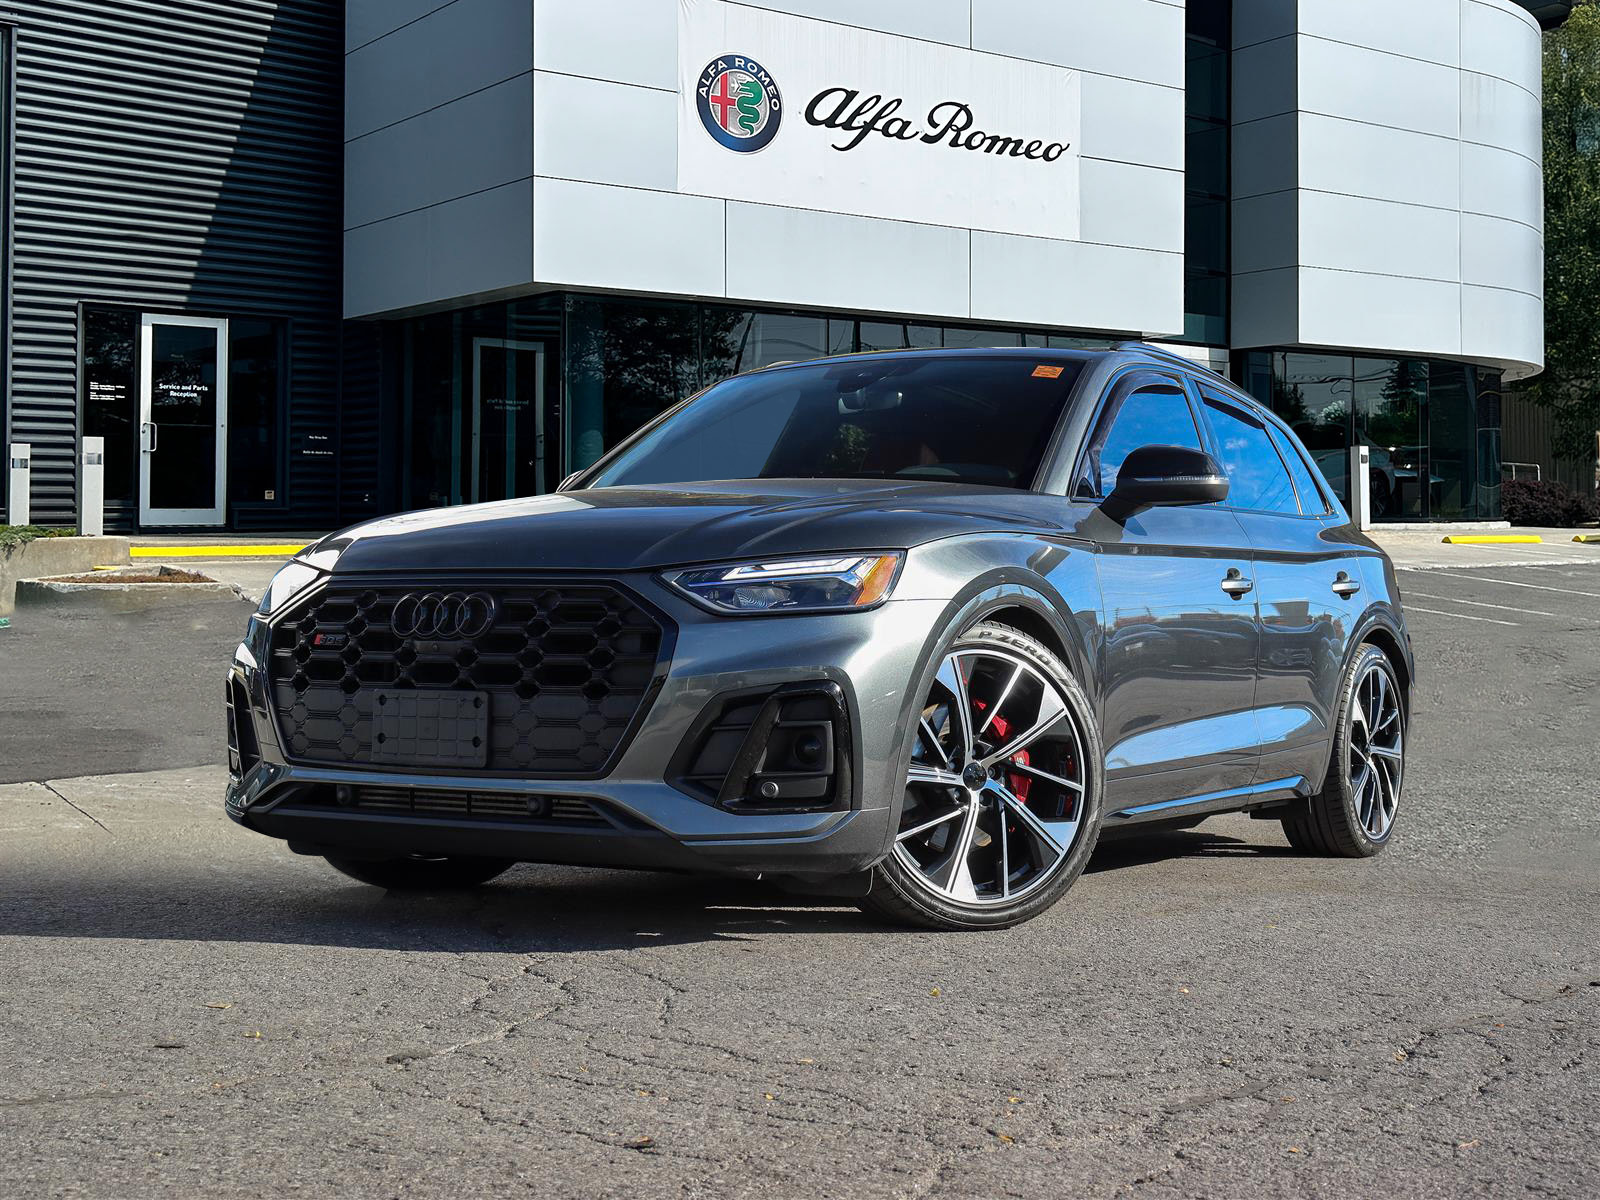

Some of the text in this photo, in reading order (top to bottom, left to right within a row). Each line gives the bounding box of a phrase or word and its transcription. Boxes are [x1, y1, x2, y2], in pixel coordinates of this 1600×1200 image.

[699, 57, 780, 111] ALFA ROMEO
[804, 87, 1071, 162] Alfa Romeo
[158, 382, 181, 390] Service
[192, 384, 209, 392] Parts
[169, 390, 198, 398] Reception
[996, 633, 1052, 666] ZERO
